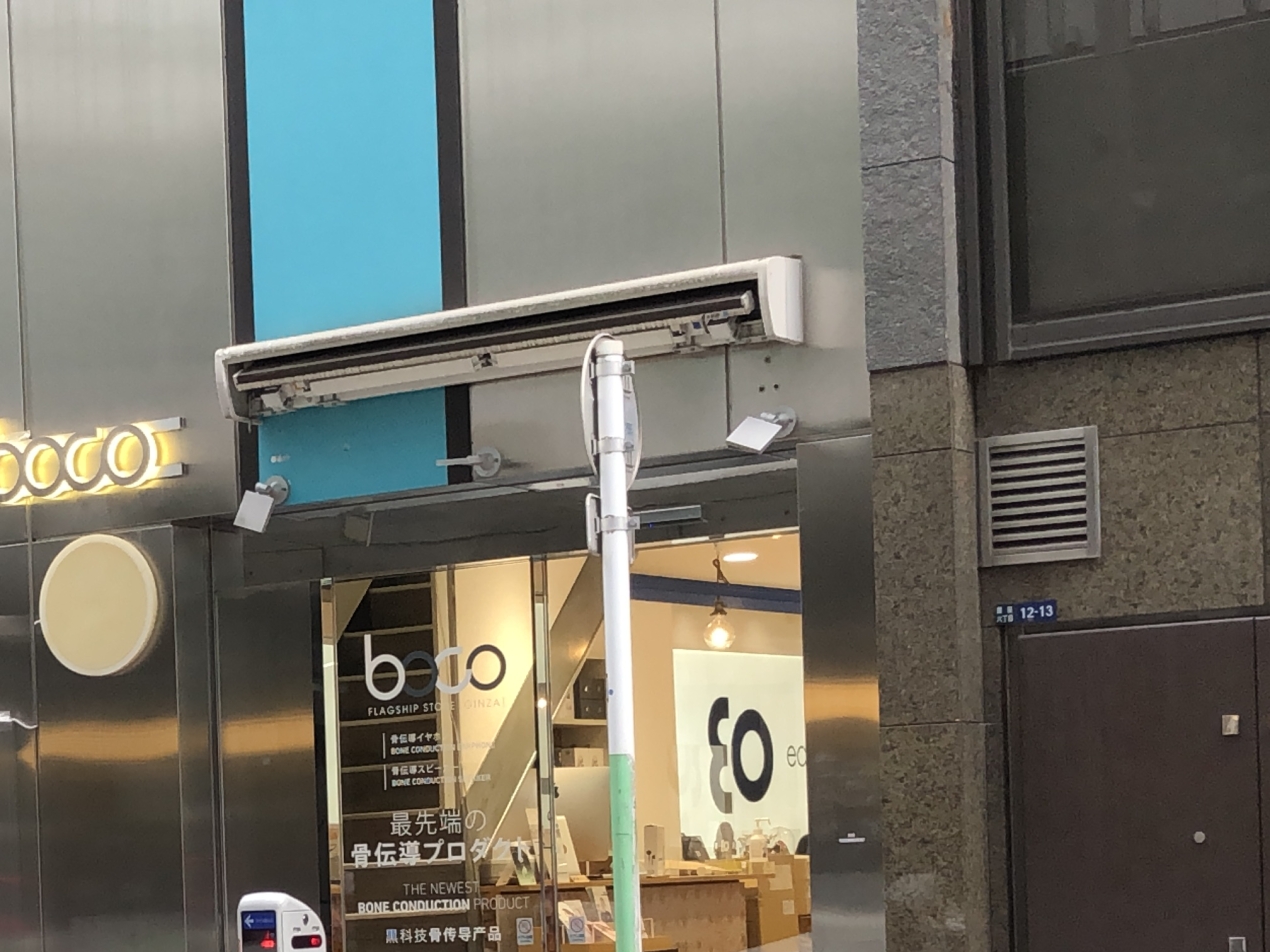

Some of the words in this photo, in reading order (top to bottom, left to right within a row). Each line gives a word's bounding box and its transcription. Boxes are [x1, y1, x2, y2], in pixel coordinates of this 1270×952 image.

[1020, 604, 1054, 619] 12-13
[364, 633, 507, 701] boco
[367, 703, 419, 717] FLAGSHIP
[423, 701, 456, 713] STOE
[411, 743, 456, 755] CONDUCTN
[412, 775, 456, 786] CONDUCTN
[390, 809, 487, 838] 最先端の
[351, 835, 531, 868] 骨伝導プロダクト
[403, 883, 427, 897] THE
[430, 880, 480, 896] NEWEST
[358, 901, 390, 915] BONE
[392, 898, 471, 913] CONDUCTION
[473, 895, 530, 911] PRODUCT
